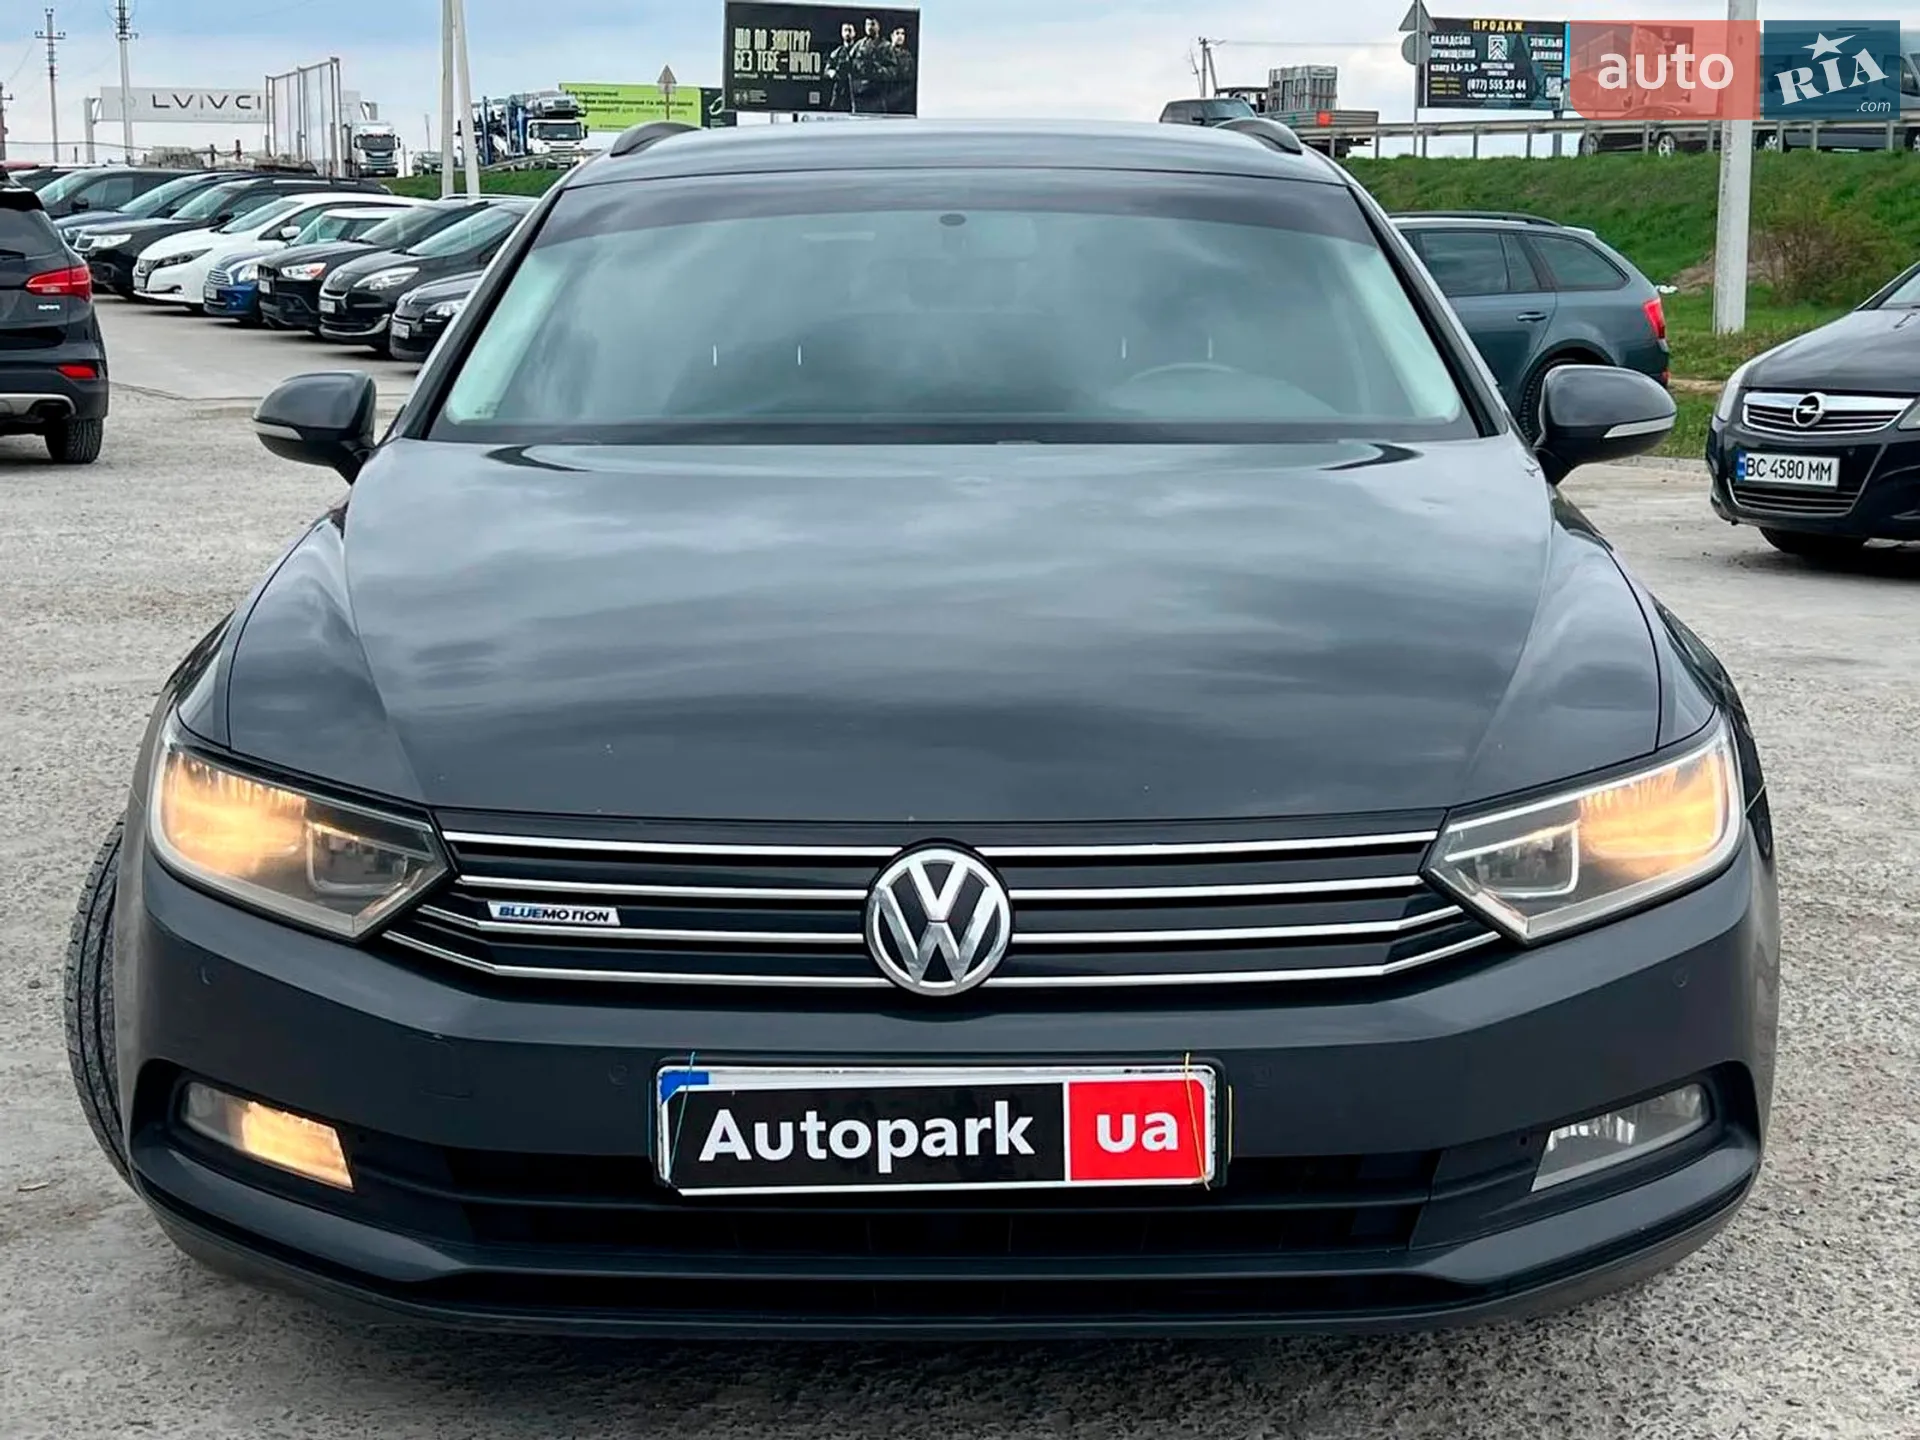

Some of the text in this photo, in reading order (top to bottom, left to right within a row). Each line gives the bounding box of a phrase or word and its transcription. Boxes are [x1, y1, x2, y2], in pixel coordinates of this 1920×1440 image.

[1473, 21, 1524, 32] ПРОДАЖ
[1489, 79, 1503, 90] 555
[1516, 80, 1527, 90] 44
[1746, 457, 1832, 481] BC 4580 MM
[499, 906, 610, 922] BLUEMOTION
[699, 1101, 1178, 1174] Autopark ua
